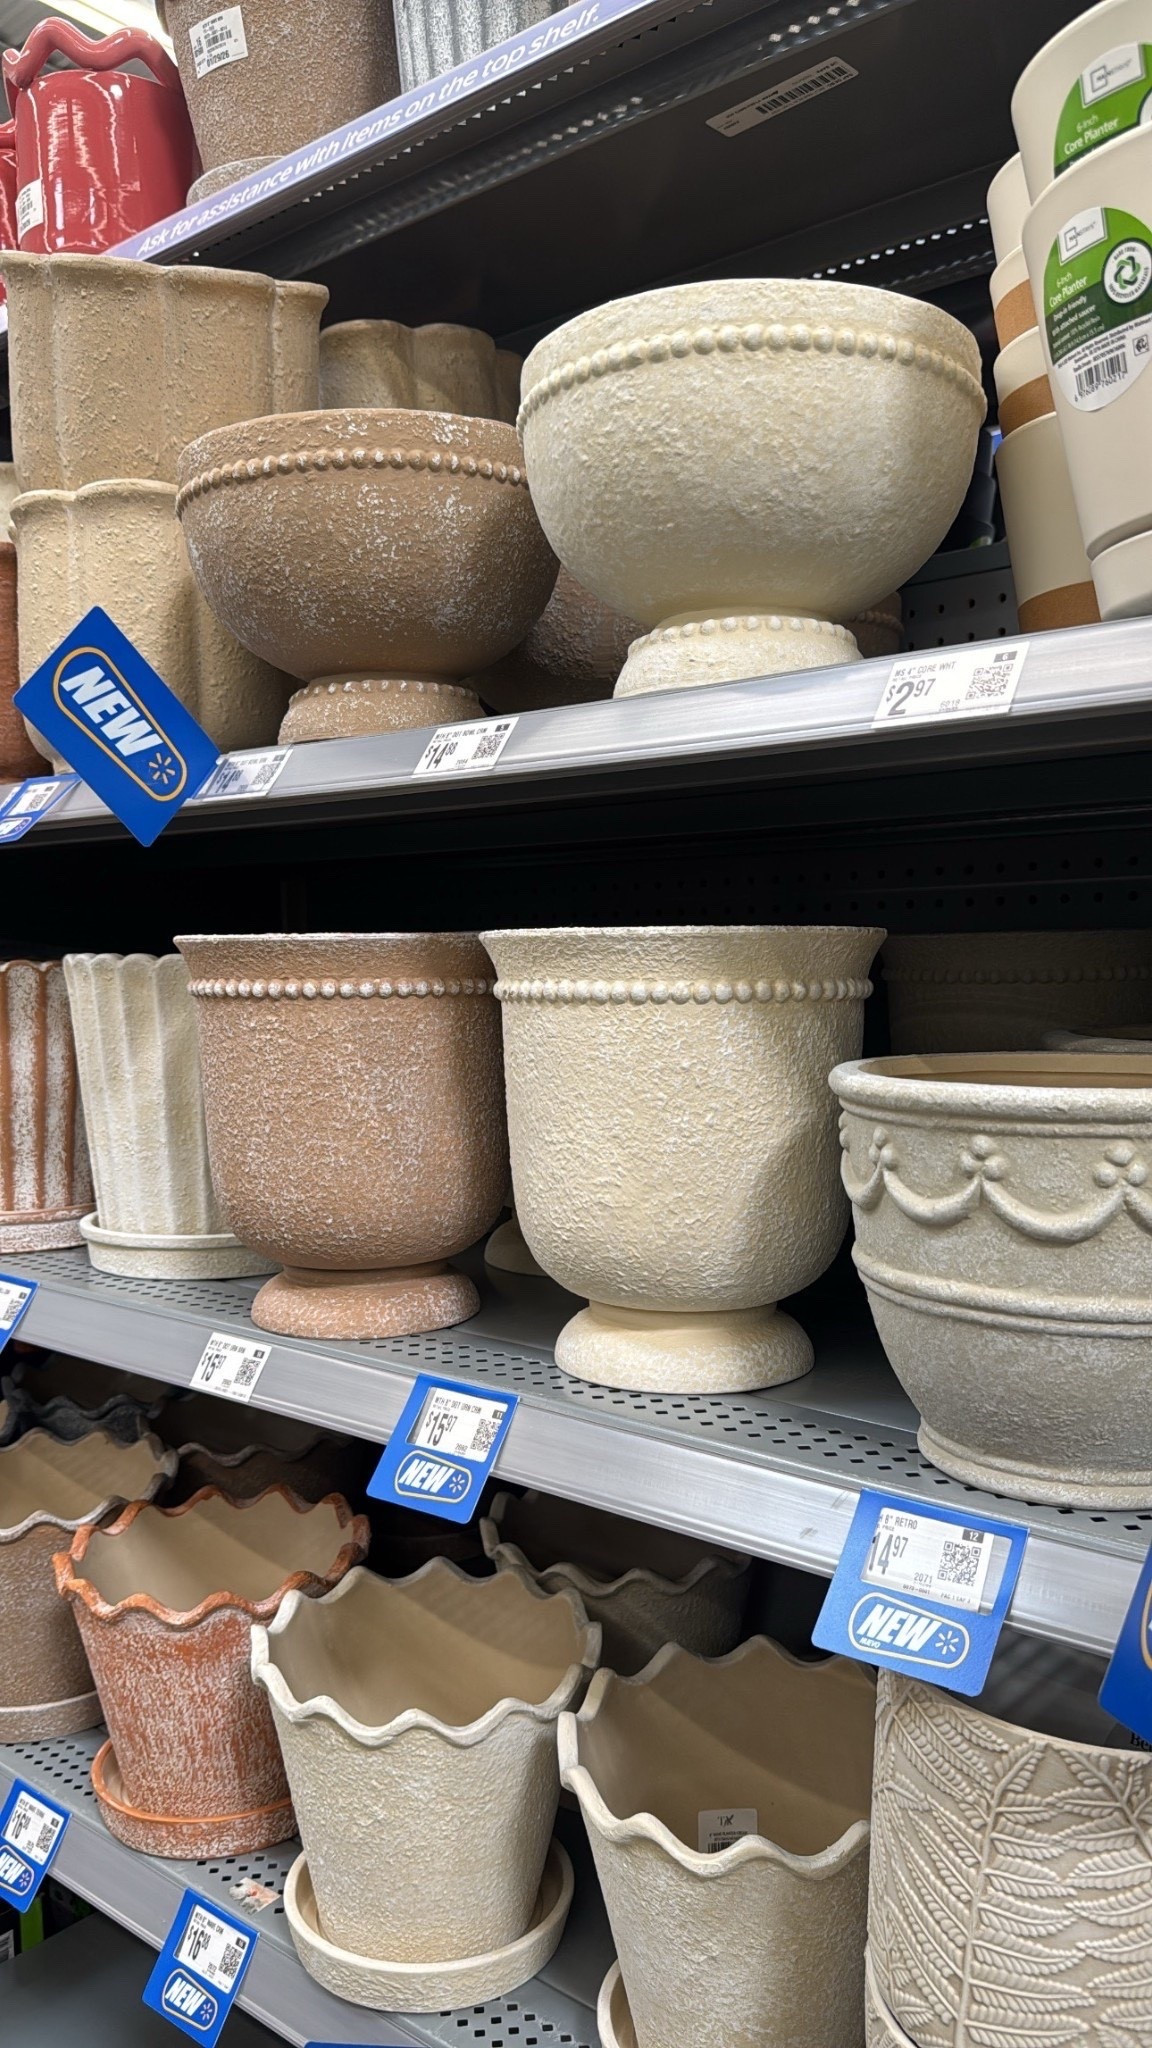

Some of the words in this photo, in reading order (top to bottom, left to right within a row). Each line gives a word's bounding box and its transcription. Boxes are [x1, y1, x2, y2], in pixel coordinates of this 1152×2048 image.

[136, 228, 172, 256] Ask
[170, 215, 199, 240] for
[197, 167, 293, 226] assistance
[295, 140, 341, 175] with
[342, 108, 403, 154] items
[405, 92, 435, 116] on
[438, 70, 476, 100] the
[482, 47, 527, 78] top
[528, 3, 599, 55] shelf.
[1064, 138, 1083, 154] Core
[1084, 118, 1118, 143] Planter
[1076, 114, 1098, 132] 6-inch
[1049, 294, 1062, 308] Core
[1062, 276, 1087, 298] Planter
[1056, 272, 1072, 288] 6-inch
[895, 668, 905, 676] MS
[917, 664, 937, 674] CORE
[939, 661, 957, 670] WHT
[60, 666, 164, 757] NEW
[398, 1459, 455, 1493] NEW
[895, 1517, 917, 1530] RETRO
[914, 1572, 933, 1583] 2071
[856, 1603, 942, 1652] NEW
[859, 1637, 881, 1649] NUEVO
[164, 1977, 207, 2016] NEW
